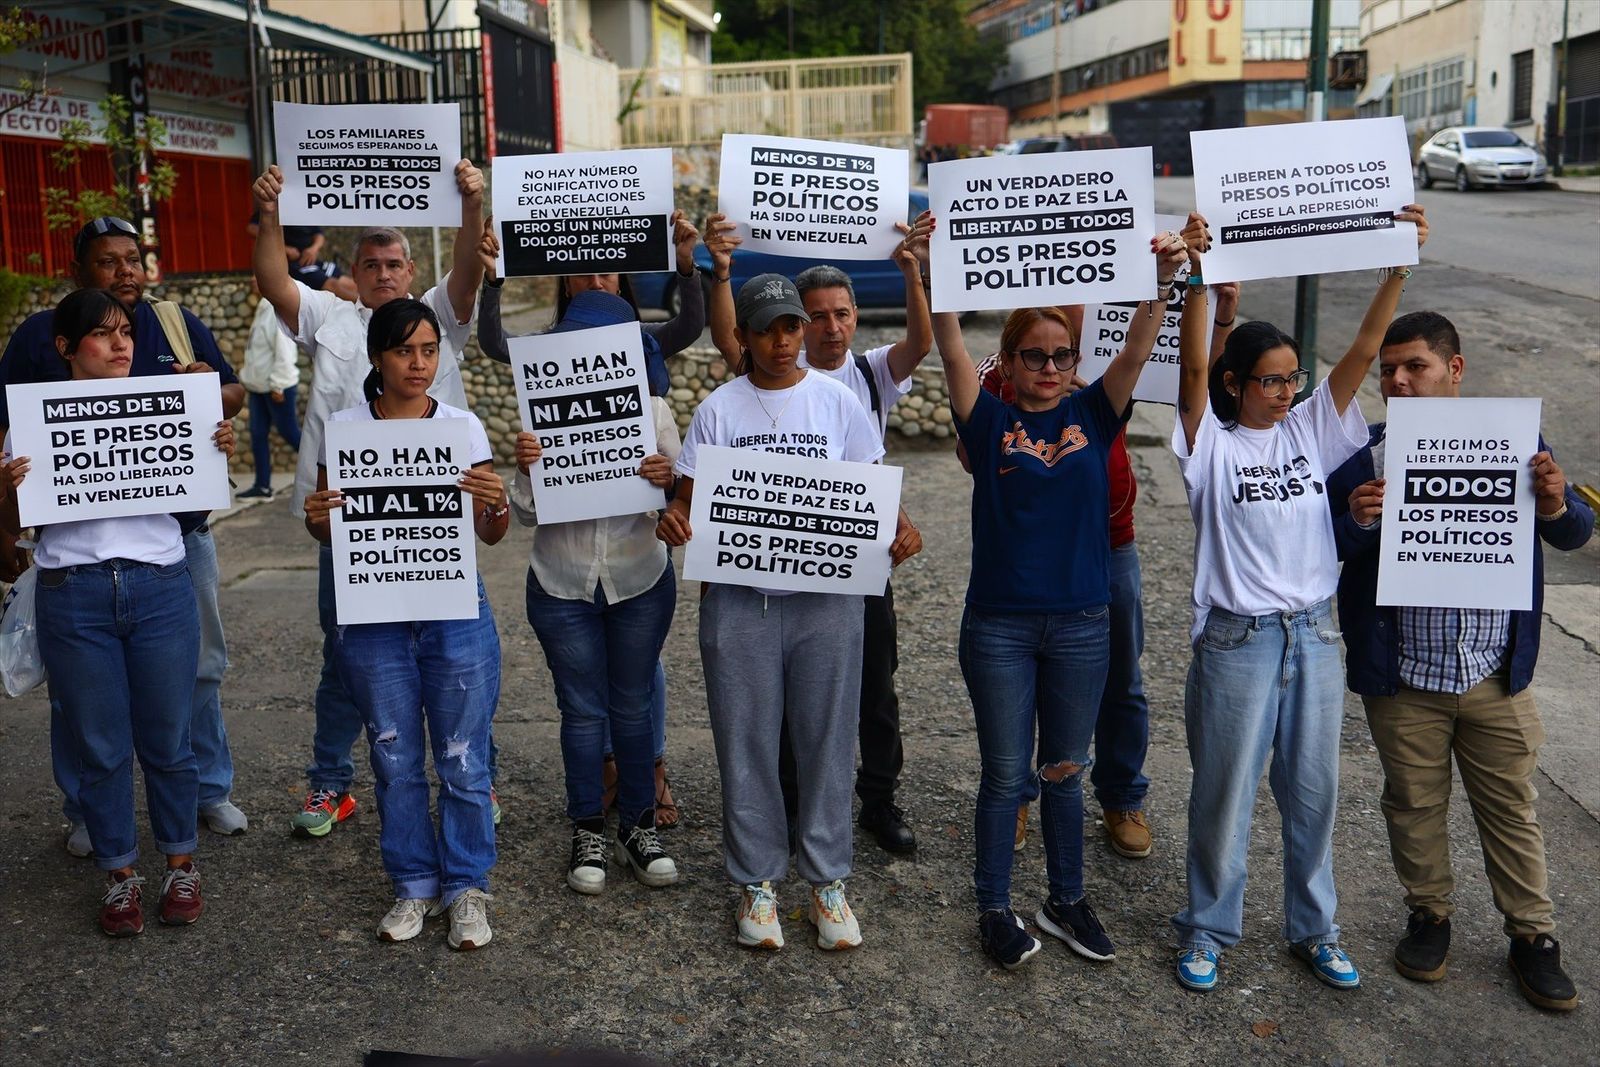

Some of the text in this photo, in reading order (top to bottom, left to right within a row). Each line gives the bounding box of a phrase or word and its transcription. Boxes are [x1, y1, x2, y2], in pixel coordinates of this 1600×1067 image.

[68, 101, 90, 119] DE
[307, 129, 425, 139] LOS FAMILIARES
[299, 142, 354, 150] SEGUIMOS
[357, 141, 422, 150] ESPERANDO
[300, 158, 439, 169] LIBERTAD DE TODOS
[754, 151, 873, 171] MENOS DE 1%
[305, 174, 430, 189] LOS PRESOS
[525, 165, 637, 179] NO HAY NÚMERO
[754, 172, 879, 193] DE PRESOS
[966, 171, 1114, 193] UN VERDADERO
[1221, 160, 1386, 187] ¡LIBEREN A TODOS LOS
[522, 178, 640, 192] SIGNIFICATIVO DE
[1222, 176, 1390, 203] PRESOS POLÍTICOS!
[307, 189, 429, 210] POLÍTICOS
[518, 191, 645, 206] EXCARCELACIONES
[753, 189, 878, 212] POLÍTICOS
[949, 189, 1128, 213] ACTO DE PAZ ES LA
[1237, 196, 1378, 222] ¡CESE LA REPRESIÓN!
[531, 206, 630, 219] EN VENEZUELA
[750, 211, 877, 226] HA SIDO LIBERADO
[514, 217, 651, 233] PERO SÍ UN NÚMERO
[953, 212, 1132, 236] LIBERTAD DE TODOS
[1225, 216, 1391, 239] #TransiciónSinPresosPolíticos
[520, 232, 647, 247] DOLORO DE PRESO
[751, 228, 867, 245] EN VENEZUELA
[546, 246, 627, 262] POLÍTICOS
[963, 239, 1116, 265] LOS PRESOS
[965, 262, 1115, 291] POLÍTICOS
[1097, 309, 1130, 323] LOS
[1094, 347, 1112, 357] EN
[523, 351, 627, 379] NO HAN
[525, 368, 636, 391] EXCARCELADO
[46, 396, 182, 418] MENOS DE 1%
[533, 393, 638, 423] NI AL 1%
[51, 421, 192, 448] DE PRESOS
[540, 424, 641, 449] DE PRESOS
[730, 433, 827, 448] LIBEREN A TODOS
[1417, 439, 1509, 451] EXIGIMOS
[53, 444, 194, 472] POLÍTICOS
[339, 447, 451, 466] NO HAN
[542, 445, 645, 470] POLÍTICOS
[1407, 455, 1519, 464] LIBERTAD PARA
[53, 465, 194, 486] HA SIDO LIBERADO
[339, 465, 459, 479] EXCARCELADO
[543, 466, 640, 487] EN VENEZUEL
[1283, 464, 1293, 476] A
[732, 469, 866, 495] UN VERDADERO
[1232, 477, 1305, 504] JESÚS
[1408, 477, 1512, 497] TODOS
[57, 484, 187, 506] EN VENEZUELA
[346, 492, 458, 515] NI AL 1%
[713, 485, 875, 514] ACTO DE PAZ ES LA
[712, 506, 876, 536] LIBERTAD DE TODOS
[1398, 509, 1518, 523] LOS PRESOS
[349, 526, 459, 542] DE PRESOS
[718, 530, 858, 559] LOS PRESOS
[1401, 527, 1513, 546] POLÍTICOS
[350, 545, 461, 566] POLÍTICOS
[717, 551, 852, 579] POLÍTICOS
[1398, 552, 1514, 564] EN VENEZUELA
[349, 569, 465, 584] EN VENEZUELA
